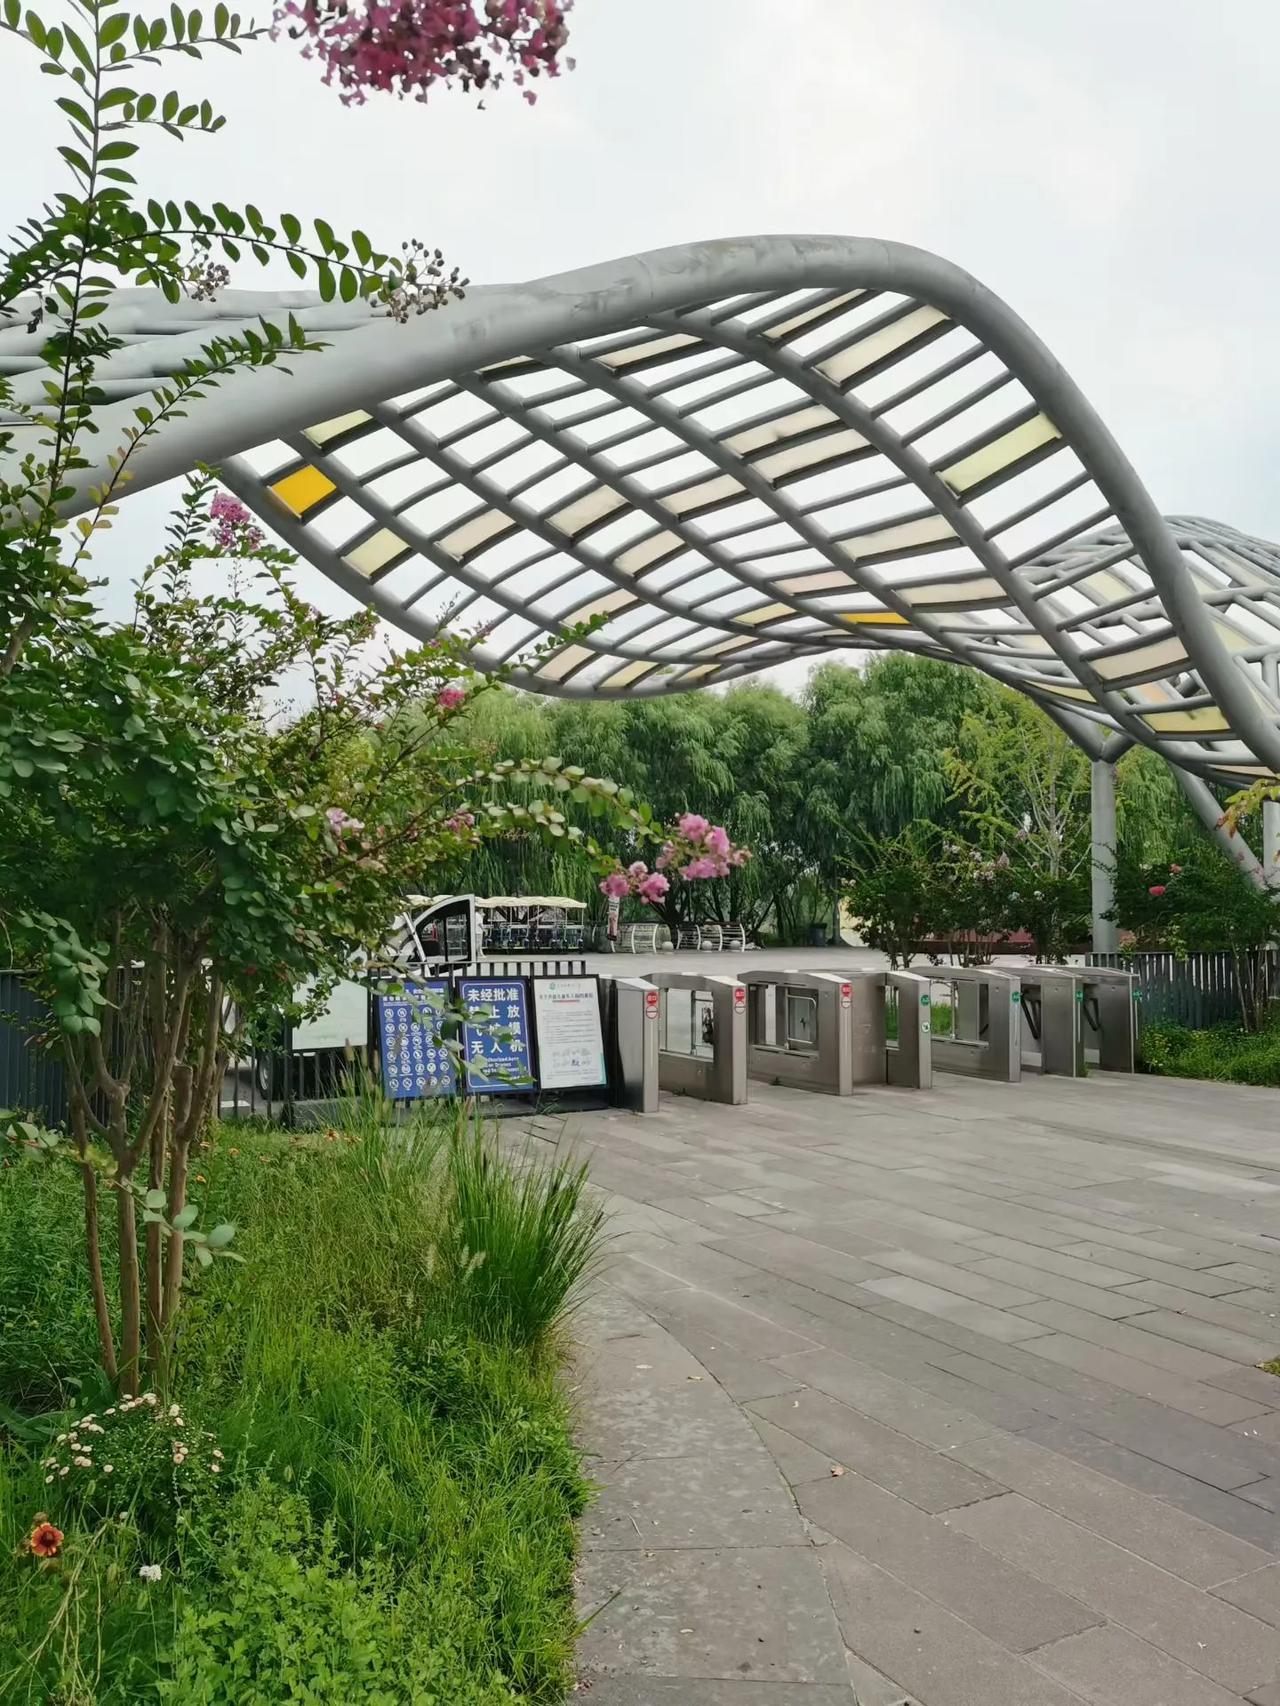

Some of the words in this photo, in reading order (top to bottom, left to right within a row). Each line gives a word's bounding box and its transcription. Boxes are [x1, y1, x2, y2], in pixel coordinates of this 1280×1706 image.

[467, 988, 519, 1002] 未经批准
[470, 1039, 523, 1054] 无人机
